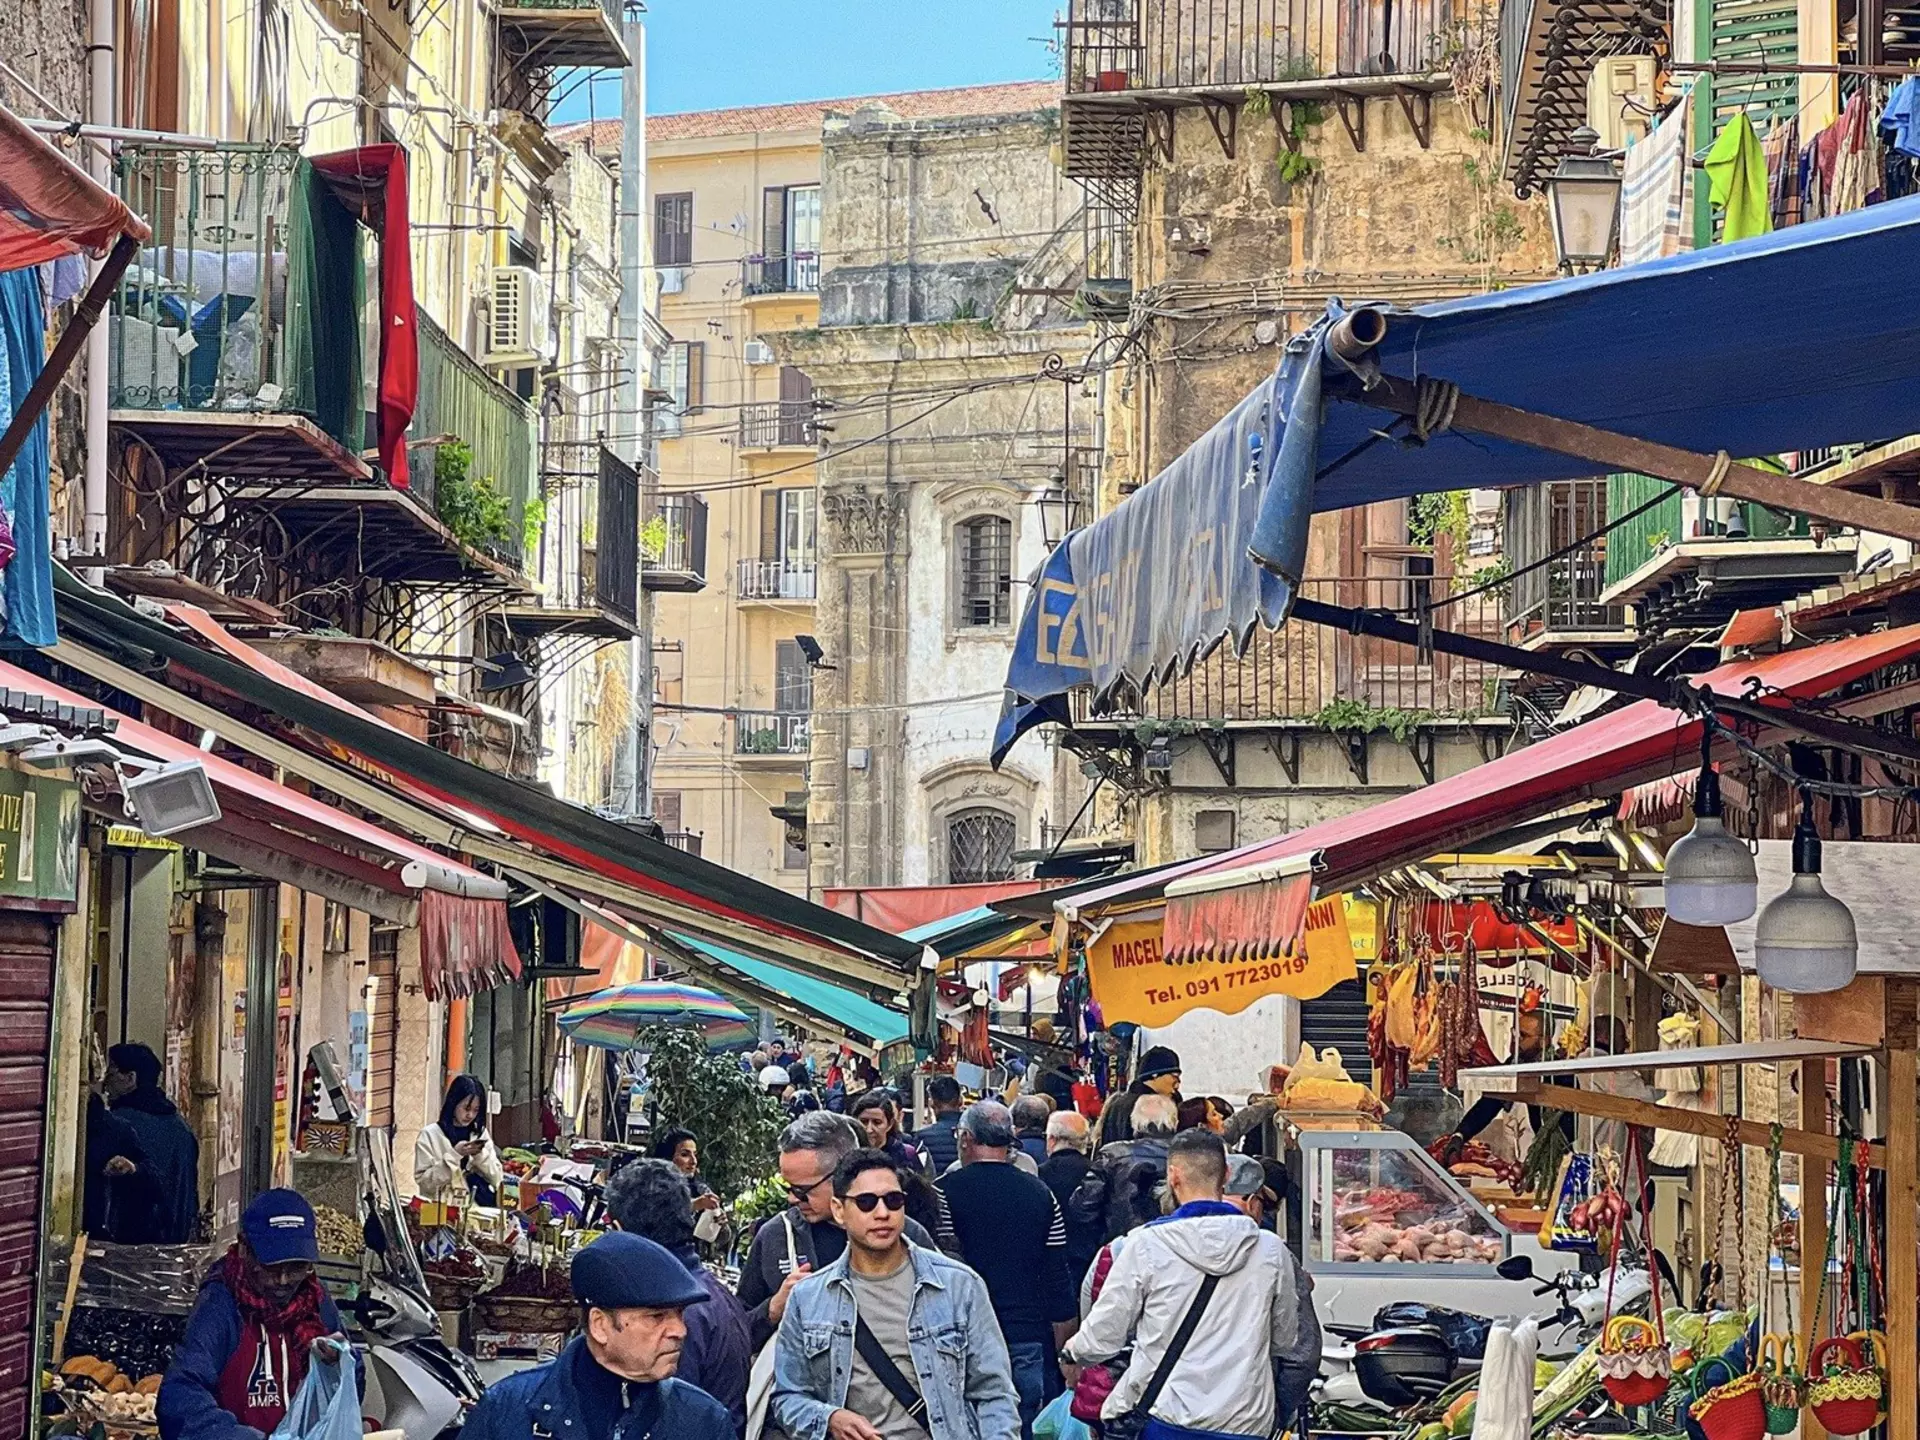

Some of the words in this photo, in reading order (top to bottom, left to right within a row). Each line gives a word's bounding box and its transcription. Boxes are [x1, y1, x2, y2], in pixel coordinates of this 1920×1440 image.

[1145, 986, 1181, 1005] Tel.
[1186, 976, 1219, 998] 091
[1224, 958, 1304, 988] 7723019
